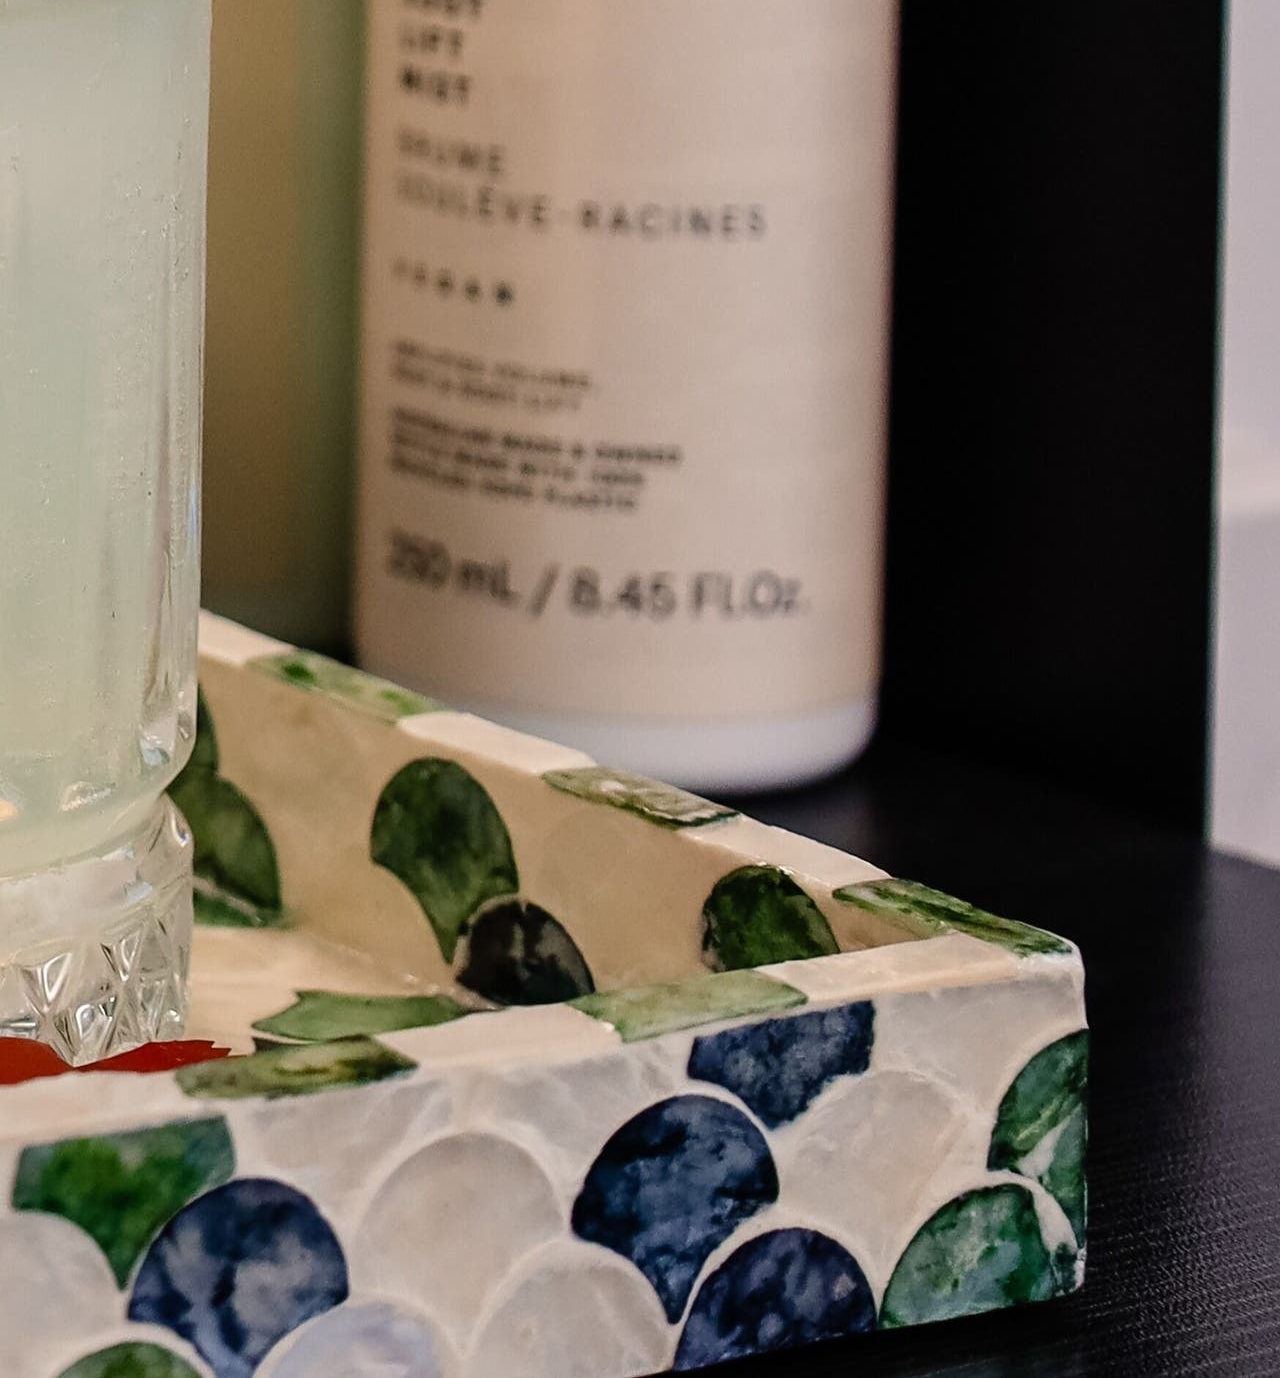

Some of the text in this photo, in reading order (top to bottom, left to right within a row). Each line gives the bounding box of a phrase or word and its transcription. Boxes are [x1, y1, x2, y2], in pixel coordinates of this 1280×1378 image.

[456, 555, 519, 602] mL
[528, 562, 560, 617] /
[567, 565, 678, 619] 8.45
